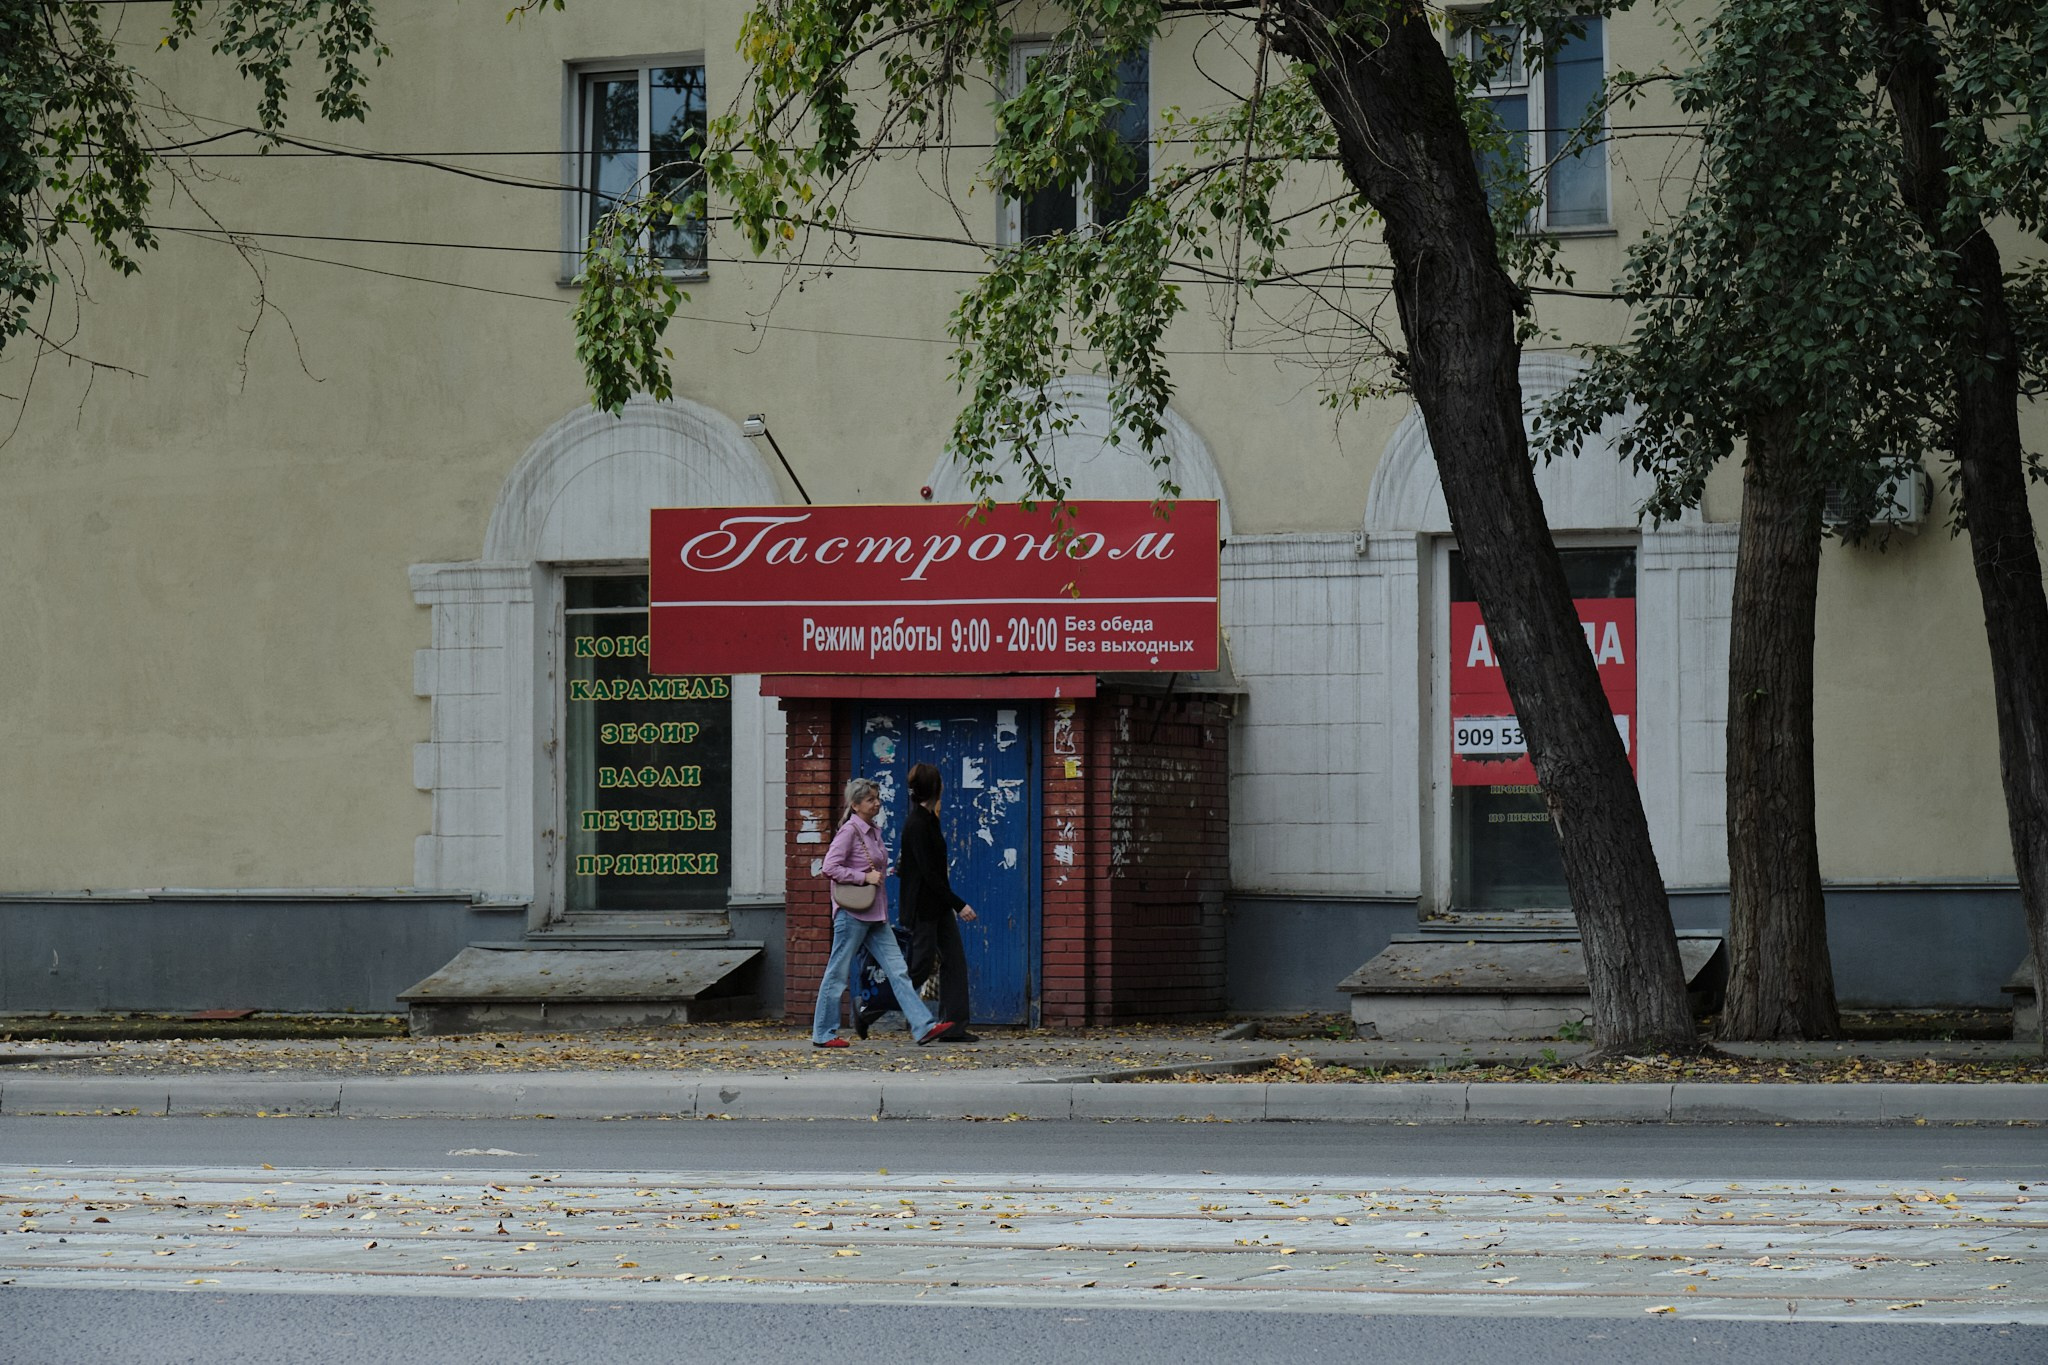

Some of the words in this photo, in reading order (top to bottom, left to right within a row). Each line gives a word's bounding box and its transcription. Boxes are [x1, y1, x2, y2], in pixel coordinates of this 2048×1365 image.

[680, 513, 1175, 581] Гастроном
[1065, 615, 1096, 632] Без
[1100, 615, 1154, 633] обеда
[803, 617, 864, 652] Режим
[870, 616, 942, 660] работы
[951, 617, 990, 653] 9:00
[1008, 616, 1058, 652] 20:00
[1065, 637, 1096, 653] Без
[1101, 638, 1194, 655] выходных
[570, 678, 730, 701] КАРАМЕЛЬ
[600, 722, 700, 745] ЗЕФИР
[1457, 728, 1494, 746] 909
[599, 766, 701, 788] ВАФЛИ
[581, 809, 717, 832] ПЕЧЕНЬЕ
[576, 853, 719, 876] ПРЯНИКИ
